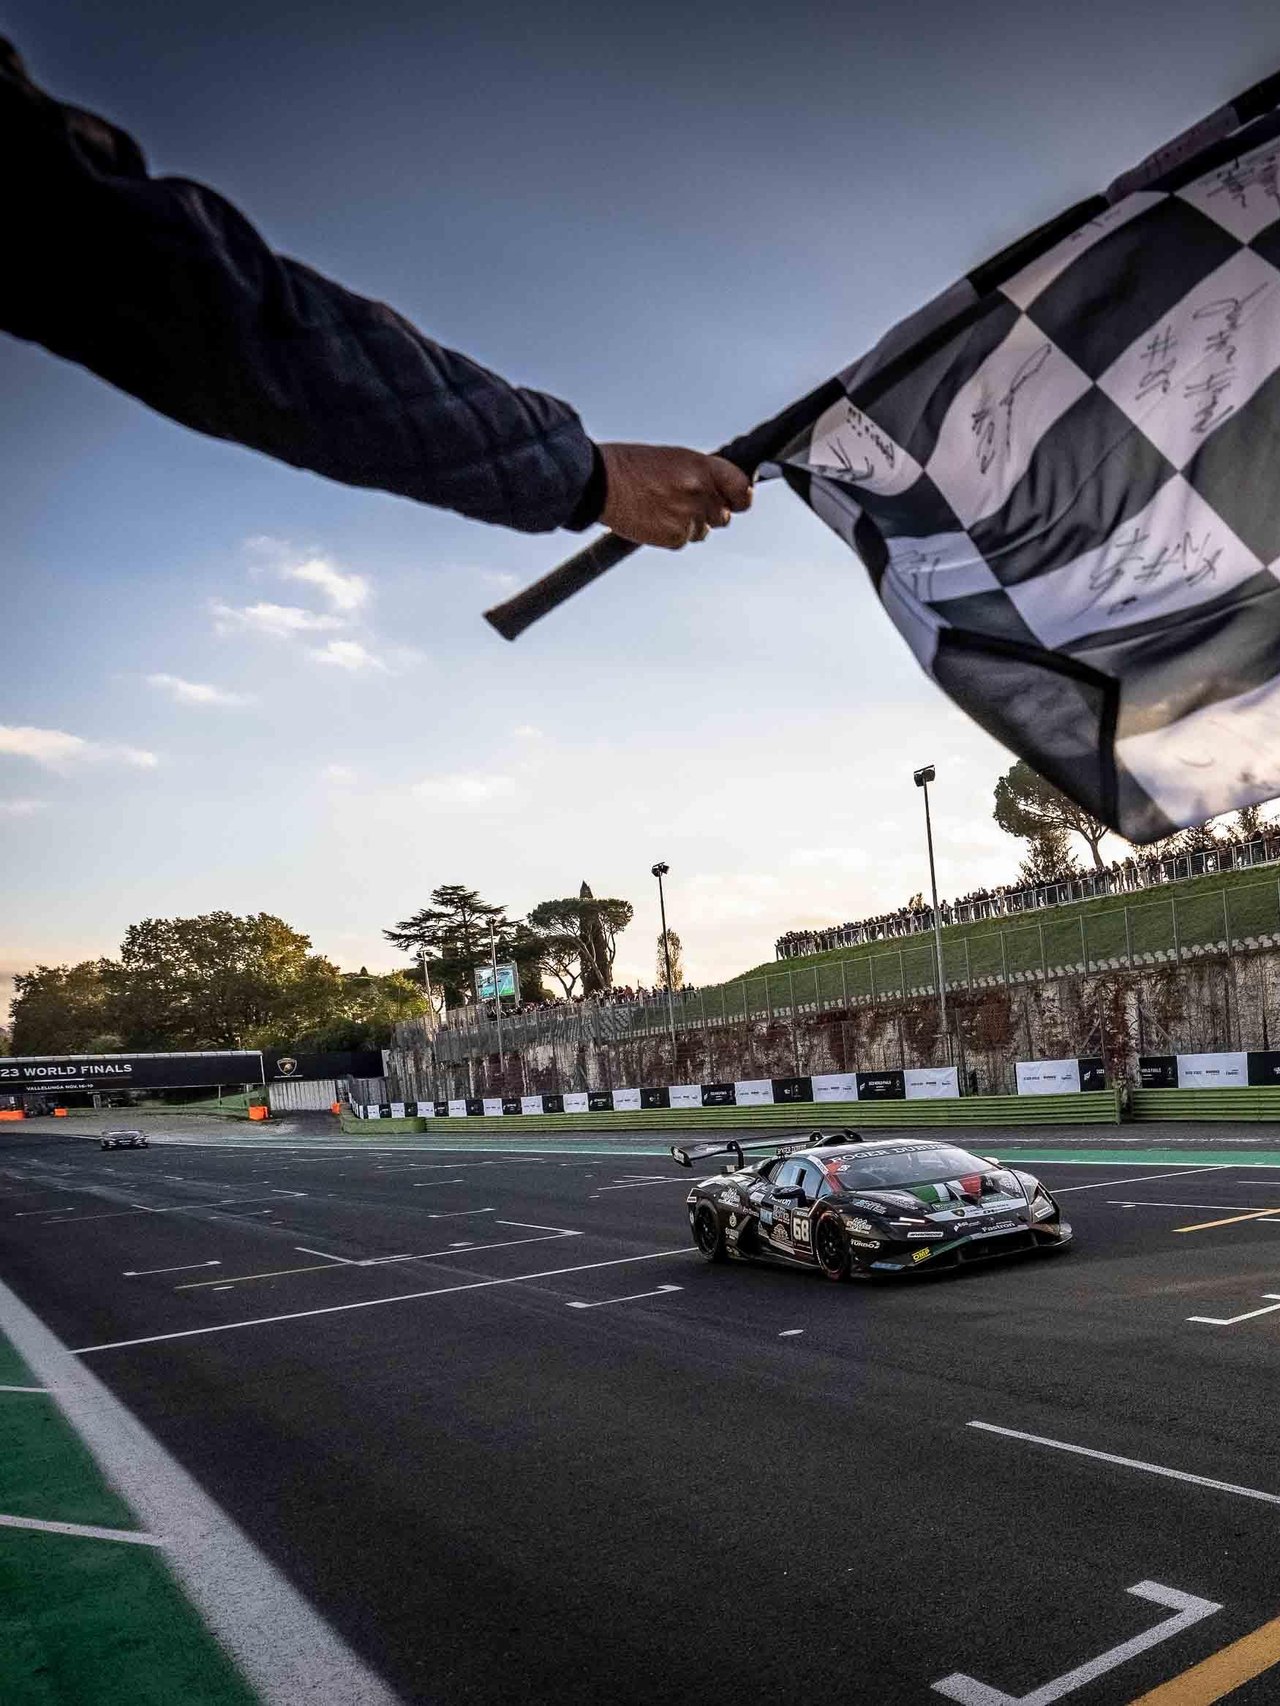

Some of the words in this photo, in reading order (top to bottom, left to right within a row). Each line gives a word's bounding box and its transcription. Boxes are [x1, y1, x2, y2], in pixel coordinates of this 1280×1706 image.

[23, 1066, 77, 1076] WORLD
[80, 1064, 133, 1074] FINALS
[831, 1149, 890, 1163] ROGER
[793, 1217, 810, 1242] 68
[981, 1222, 1016, 1233] Fastron
[851, 1239, 875, 1249] TURBO
[912, 1248, 931, 1261] OMP
